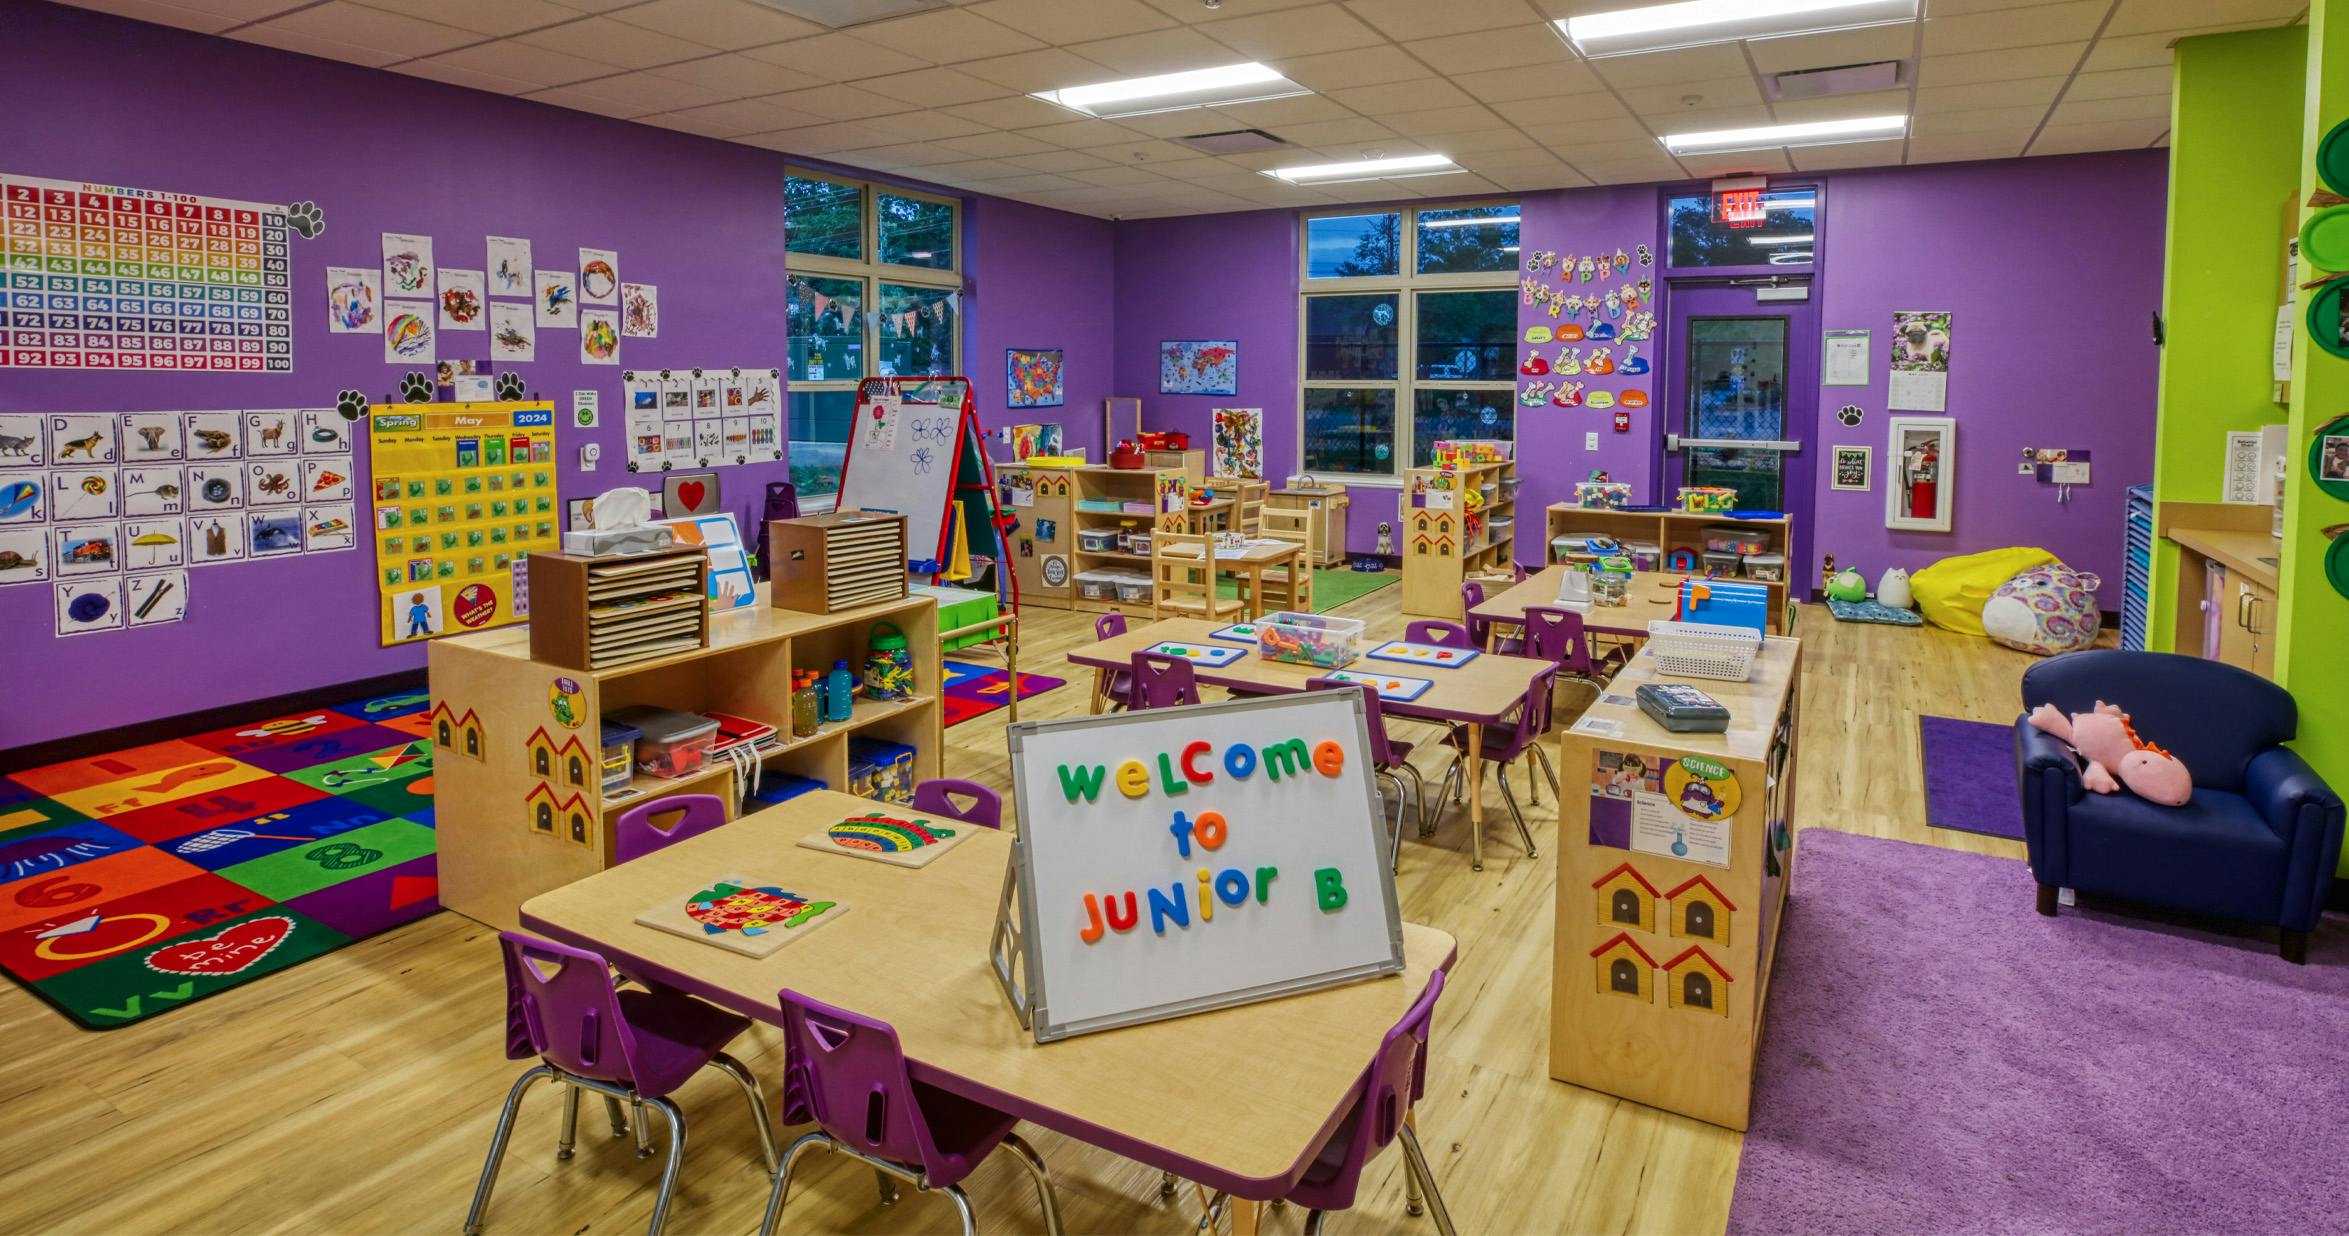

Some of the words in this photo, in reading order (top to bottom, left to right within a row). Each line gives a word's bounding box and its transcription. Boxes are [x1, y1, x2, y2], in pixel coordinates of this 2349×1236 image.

[83, 183, 154, 199] NUMBERS
[160, 193, 197, 203] 1-100
[19, 189, 29, 201] 2
[54, 192, 66, 204] 3
[89, 196, 100, 208] 4
[122, 200, 133, 211] 5
[154, 203, 164, 214] 6
[184, 206, 194, 217] 7
[214, 210, 223, 221] 8
[242, 212, 251, 224] 9
[266, 215, 283, 226] 10
[1722, 191, 1759, 220] EXIT
[266, 230, 283, 241] 20
[266, 245, 284, 256] 30
[267, 260, 284, 270] 40
[267, 274, 285, 285] 50
[16, 276, 39, 288] 52
[52, 278, 74, 290] 53
[86, 280, 109, 292] 54
[119, 283, 140, 294] 55
[151, 285, 172, 296] 56
[182, 287, 202, 298] 57
[212, 289, 231, 300] 58
[240, 291, 258, 301] 59
[268, 292, 286, 303] 60
[16, 295, 40, 307] 62
[52, 297, 75, 309] 63
[87, 299, 109, 311] 64
[120, 301, 141, 312] 65
[152, 303, 172, 314] 66
[183, 304, 202, 315] 67
[212, 306, 231, 317] 68
[240, 308, 258, 318] 69
[268, 309, 286, 320] 70
[17, 314, 41, 326] 72
[52, 316, 75, 328] 73
[87, 318, 109, 329] 74
[120, 319, 141, 330] 75
[152, 320, 172, 332] 76
[182, 322, 202, 333] 77
[212, 323, 232, 334] 78
[241, 324, 259, 335] 79
[270, 326, 286, 337] 80
[18, 333, 42, 345] 82
[54, 335, 76, 346] 83
[88, 336, 110, 347] 84
[121, 337, 142, 348] 85
[153, 338, 173, 349] 86
[183, 339, 203, 350] 87
[213, 340, 232, 351] 88
[241, 341, 259, 352] 89
[270, 342, 287, 353] 90
[18, 352, 42, 364] 92
[54, 353, 77, 365] 93
[88, 354, 110, 366] 94
[121, 355, 142, 366] 95
[153, 356, 174, 367] 96
[184, 357, 203, 367] 97
[213, 358, 232, 368] 98
[241, 358, 260, 368] 99
[268, 360, 289, 368] 100
[124, 416, 132, 426] E
[188, 416, 196, 428] F
[250, 416, 260, 427] G
[307, 414, 317, 425] H
[380, 419, 417, 429] Spring
[455, 416, 483, 426] May
[519, 414, 547, 423] 2024
[55, 419, 67, 431] D
[287, 441, 294, 451] g
[339, 438, 347, 449] h
[104, 449, 113, 460] d
[171, 449, 180, 457] e
[232, 445, 239, 456] f
[253, 466, 264, 476] O
[308, 463, 316, 473] P
[130, 473, 144, 483] M
[193, 472, 204, 481] N
[58, 477, 68, 490] L
[32, 506, 40, 519] k
[164, 503, 178, 511] m
[252, 515, 265, 524] W
[310, 510, 319, 520] X
[193, 521, 203, 530] V
[60, 531, 72, 542] T
[129, 526, 140, 537] U
[132, 580, 142, 591] Z
[62, 586, 73, 597] Y
[461, 606, 483, 620] WHAT'S
[482, 600, 494, 608] THE
[465, 607, 493, 624] WEATHER?
[110, 613, 118, 622] y
[1681, 756, 1727, 778] SCIENCE
[95, 797, 144, 814] Ff
[176, 795, 258, 818] 4
[1170, 811, 1227, 857] to
[305, 843, 383, 870] 8
[14, 876, 103, 907] 6
[1314, 868, 1348, 911] B
[180, 941, 234, 961] be
[189, 935, 275, 970] mine
